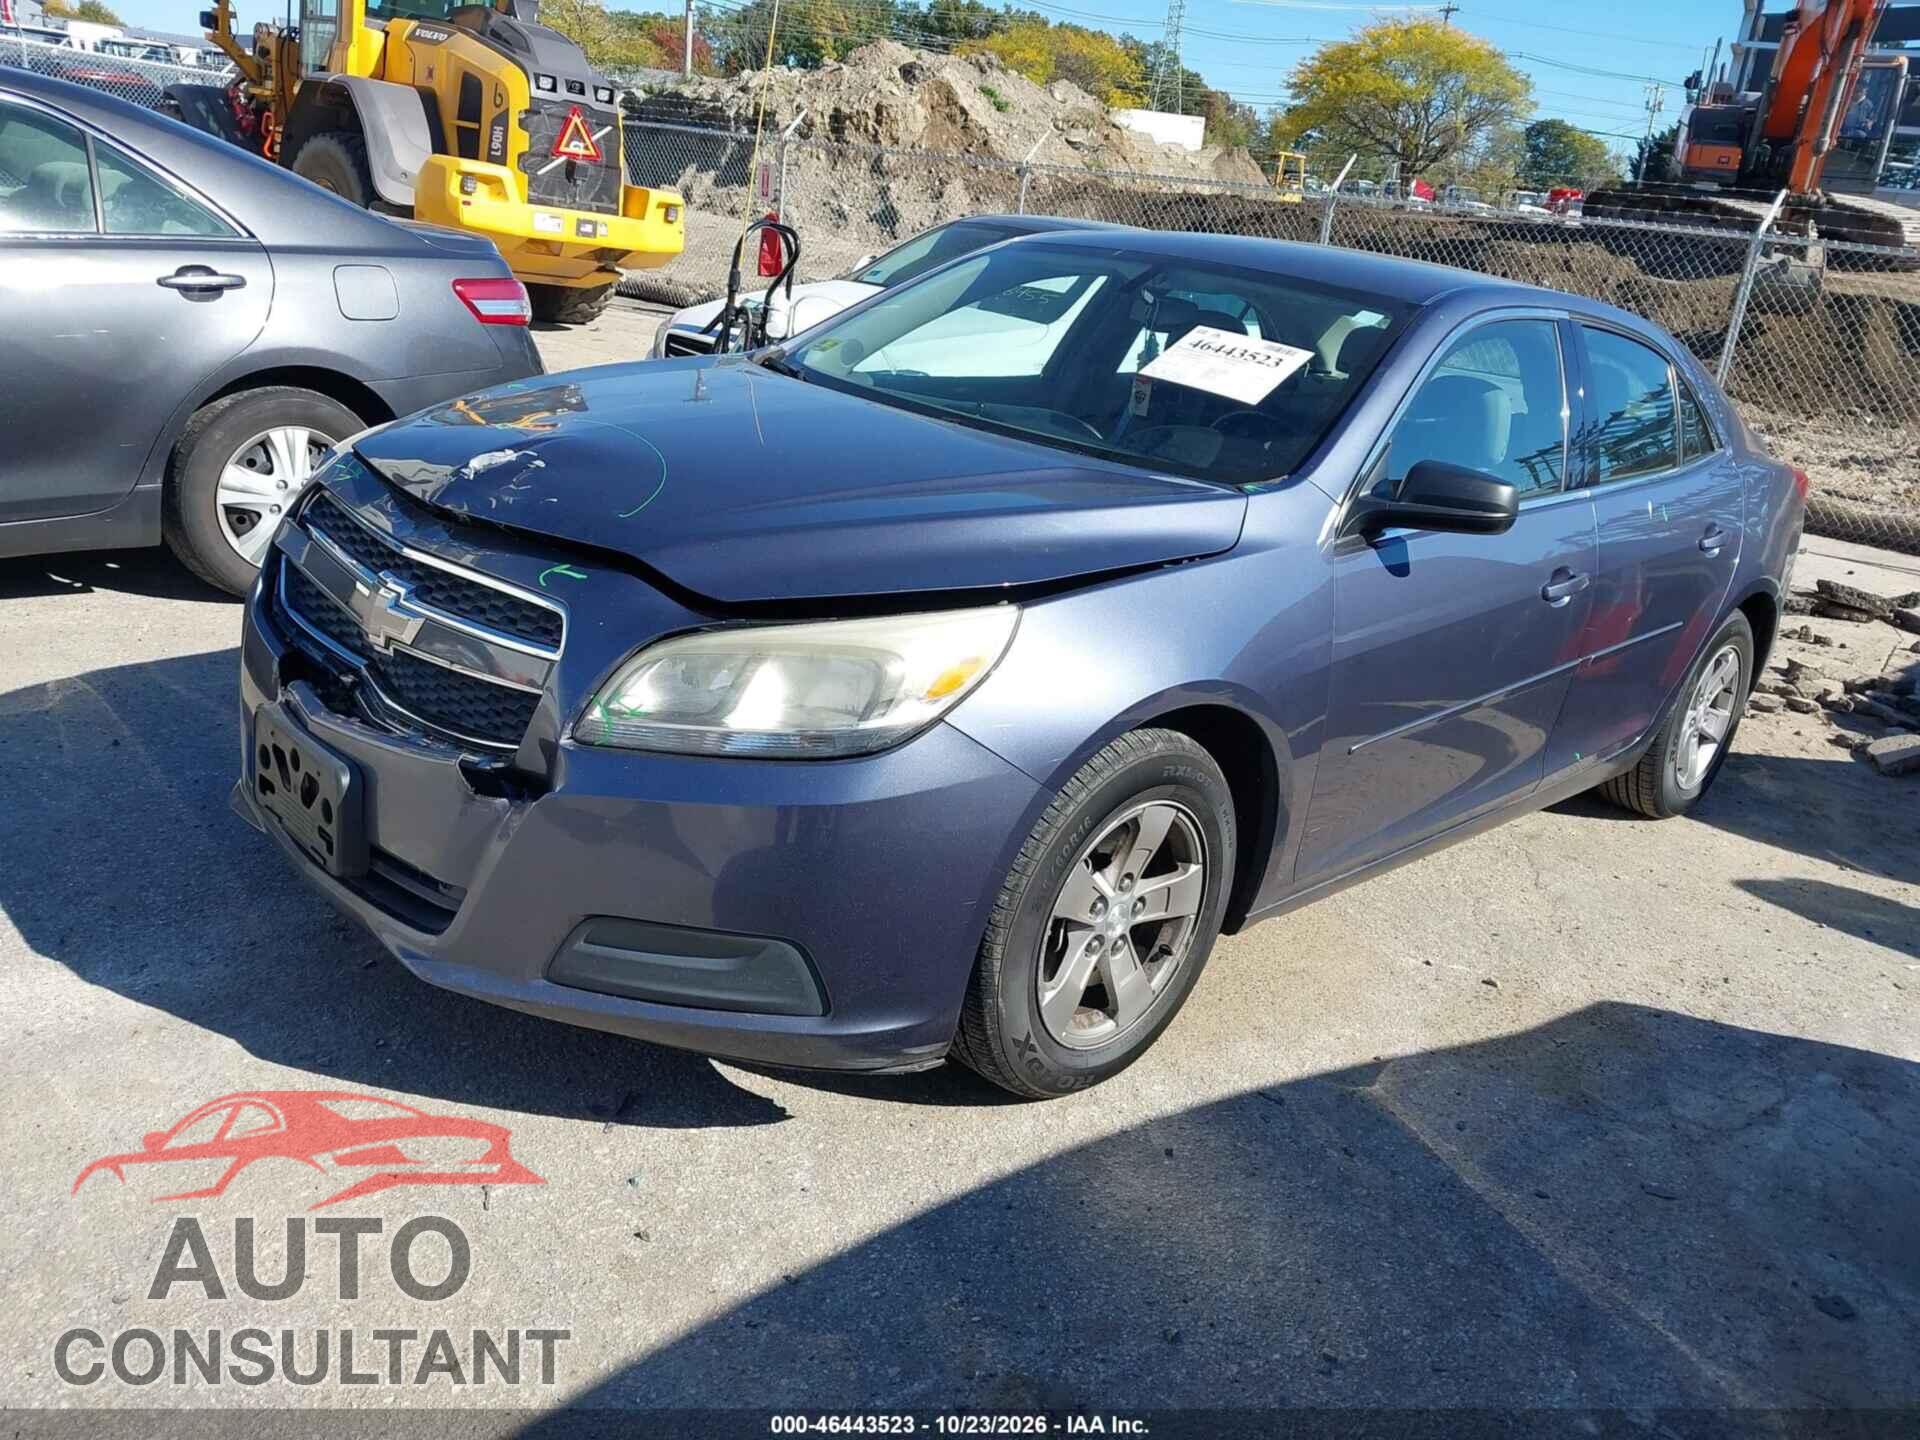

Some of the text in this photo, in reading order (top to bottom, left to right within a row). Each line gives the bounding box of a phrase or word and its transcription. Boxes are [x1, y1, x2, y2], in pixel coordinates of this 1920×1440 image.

[415, 28, 449, 41] VOLVO
[490, 125, 505, 157] L90H
[1188, 339, 1284, 369] 46443523
